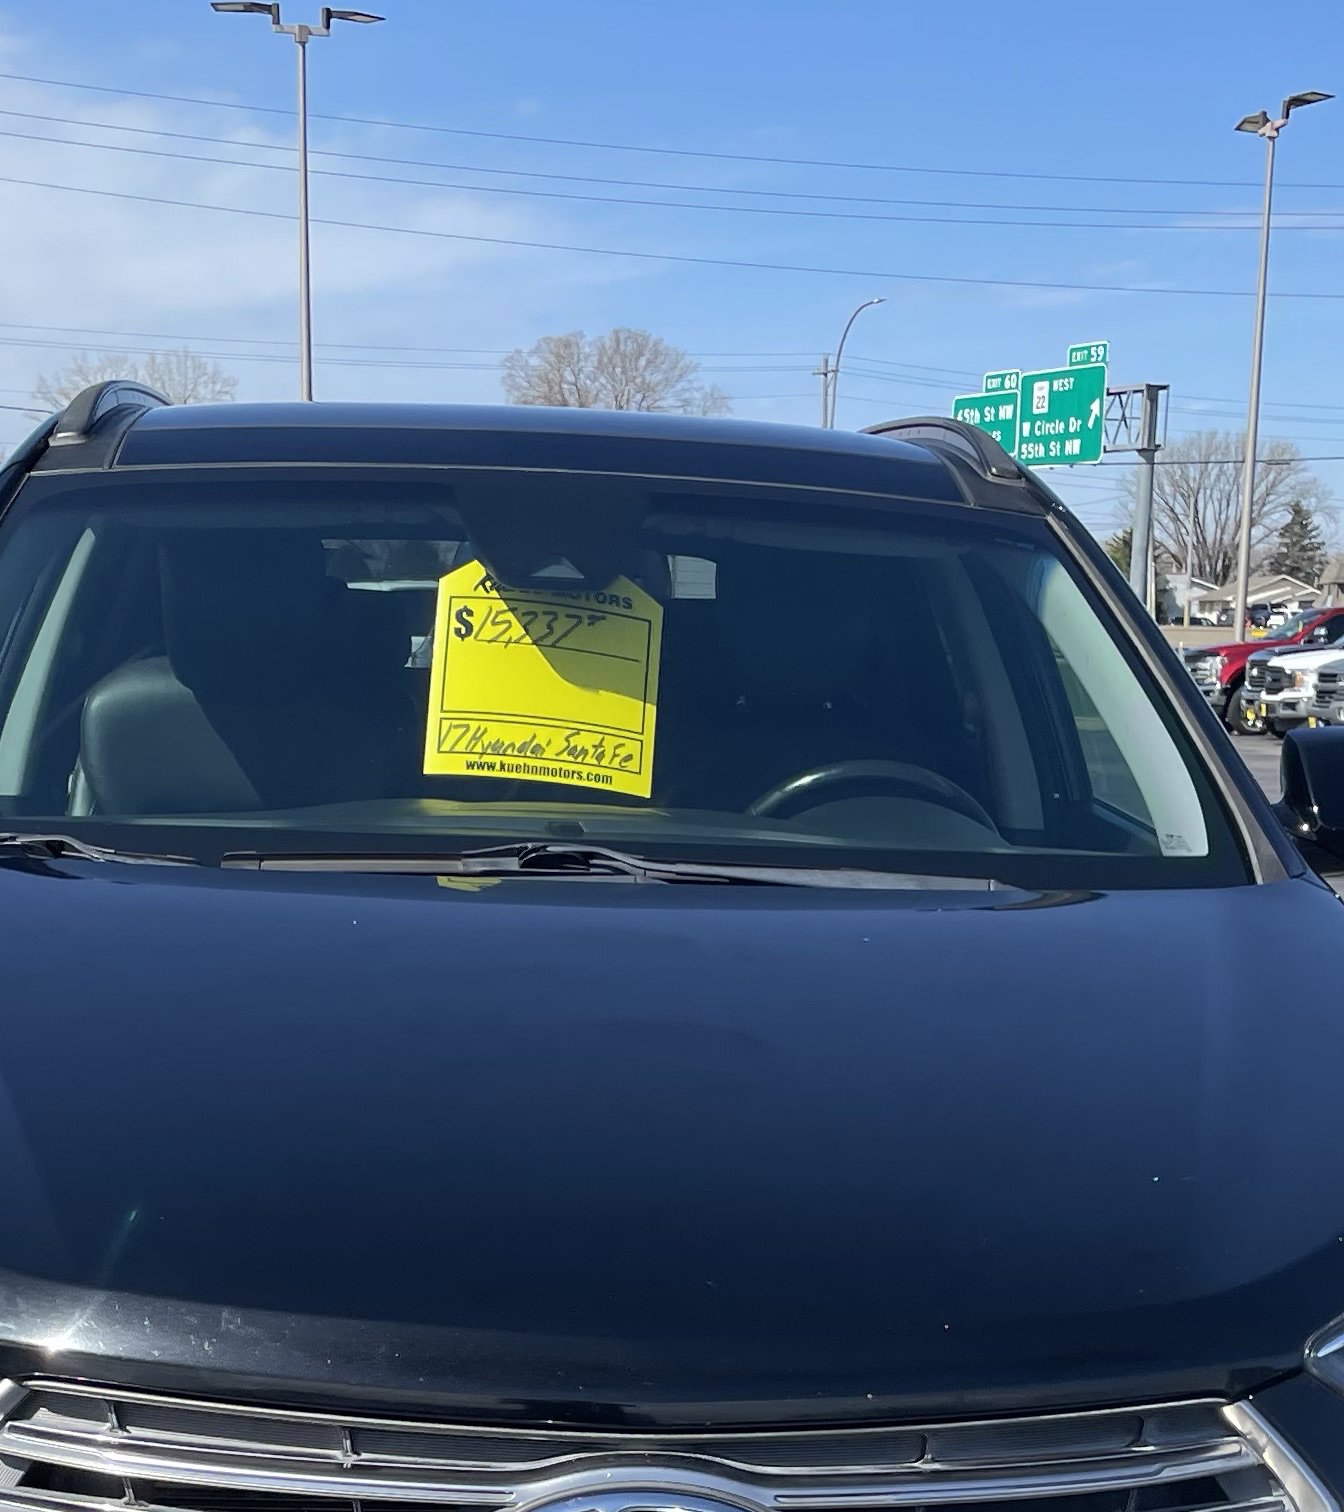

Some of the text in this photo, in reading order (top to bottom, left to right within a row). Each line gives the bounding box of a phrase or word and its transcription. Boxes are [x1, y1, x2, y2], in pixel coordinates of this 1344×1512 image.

[1090, 346, 1105, 362] 59
[986, 377, 1002, 390] EXIT
[1004, 373, 1018, 389] 60
[1052, 377, 1075, 391] WEST
[1035, 395, 1047, 410] 22
[983, 406, 996, 423] St
[998, 403, 1014, 421] NW
[1022, 421, 1031, 438] W
[1034, 418, 1065, 437] Circle
[1068, 416, 1083, 433] Dr
[1021, 438, 1082, 460] 55th St NW
[465, 724, 552, 759] Hyundai
[555, 730, 609, 767] Santa
[608, 742, 634, 769] Fe
[465, 759, 613, 785] www.kuehnmotors.com
